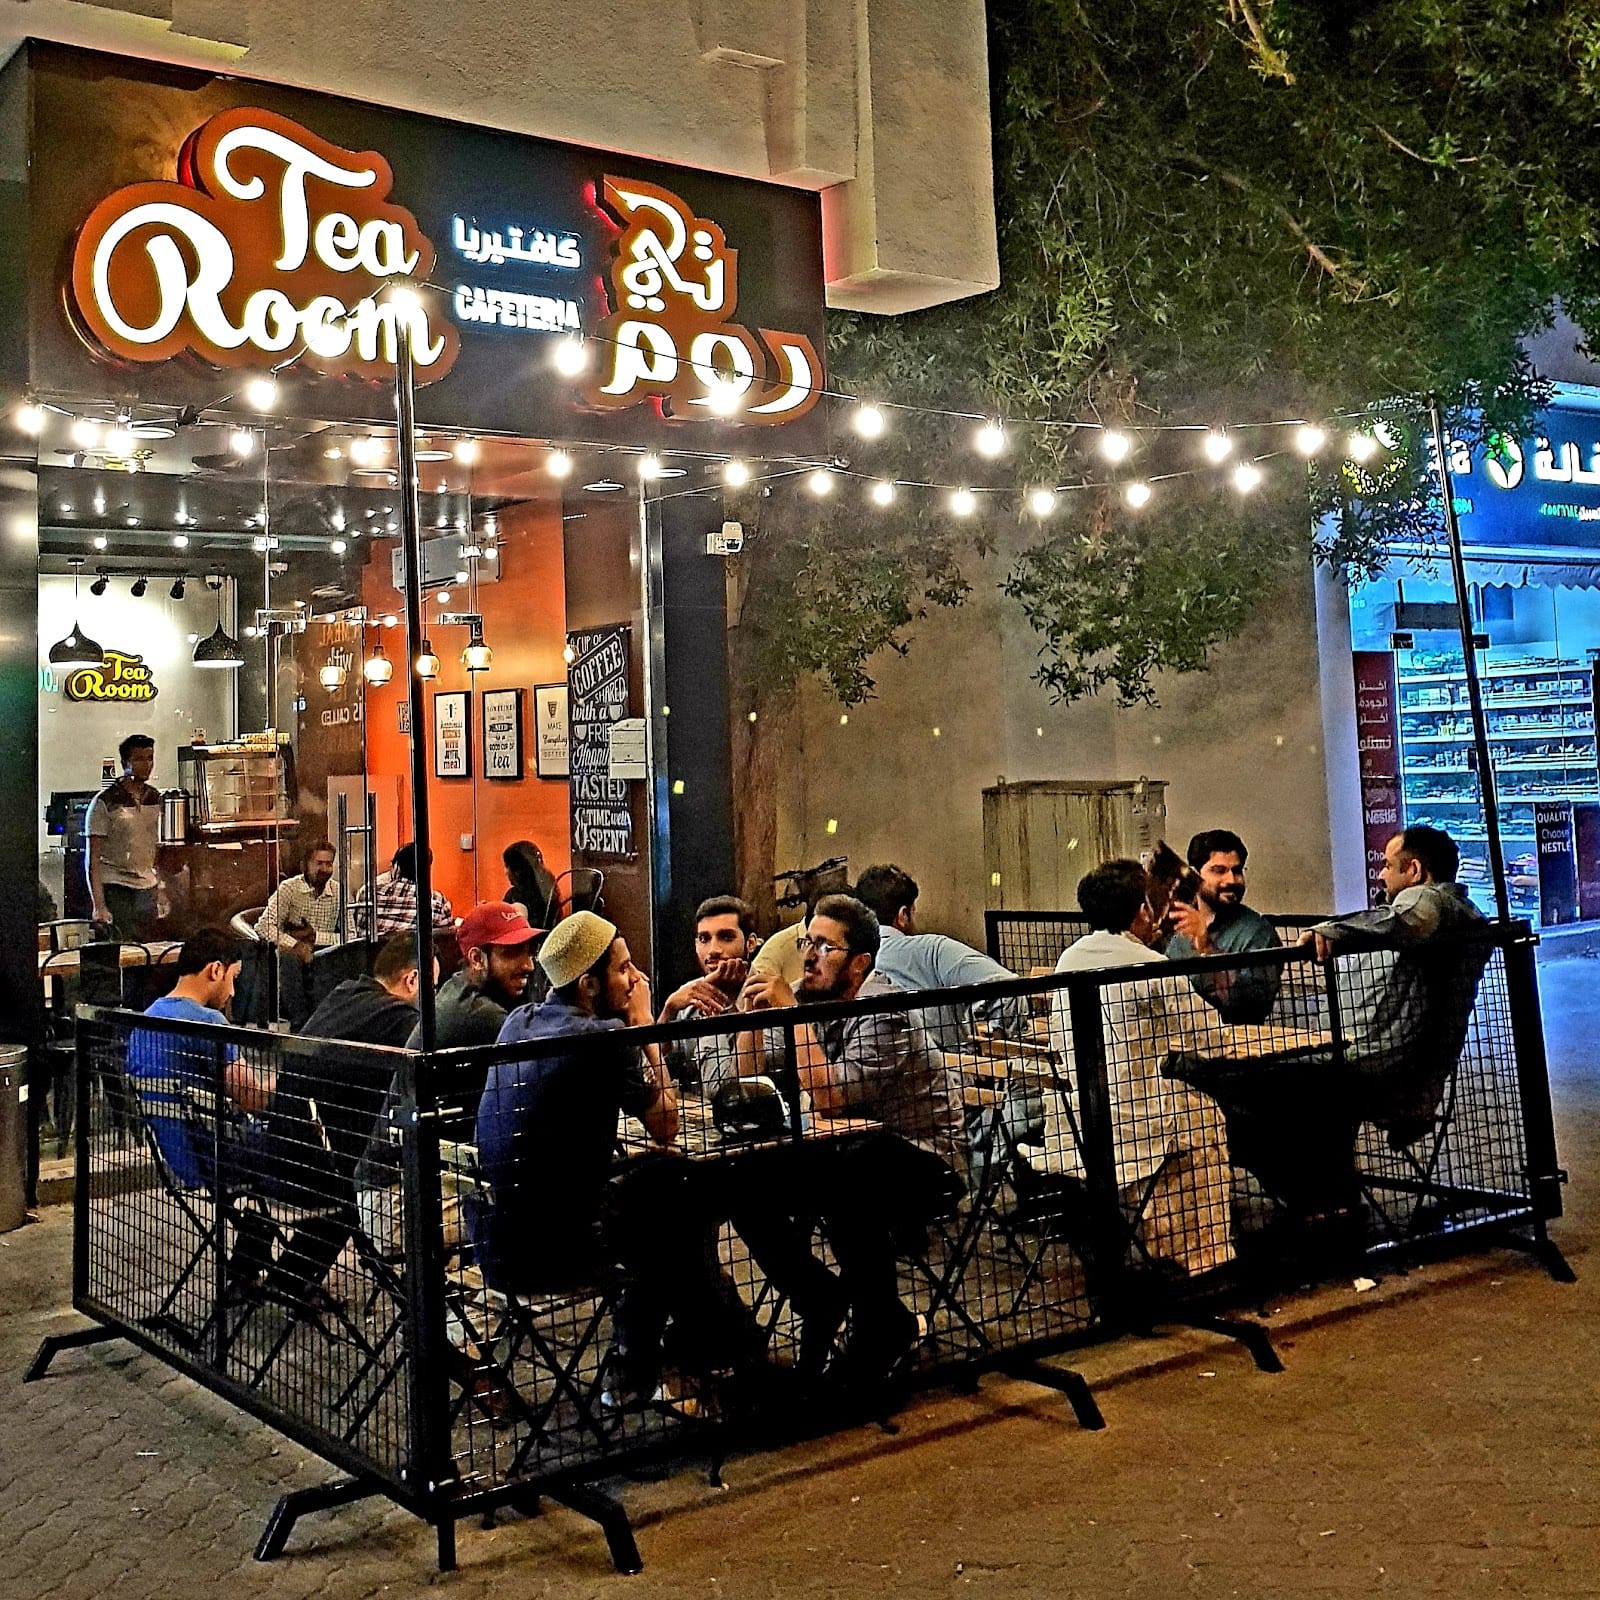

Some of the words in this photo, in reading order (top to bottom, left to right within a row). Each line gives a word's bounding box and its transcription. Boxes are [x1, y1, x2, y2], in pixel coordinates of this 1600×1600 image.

[214, 126, 419, 277] Tea
[454, 216, 581, 268] كافتيريا
[93, 202, 445, 367] Room
[456, 284, 581, 333] CAFETERIA
[600, 320, 812, 414] روم
[577, 635, 591, 656] CUP
[593, 633, 603, 646] OF
[102, 652, 149, 681] Tea
[574, 640, 621, 695] COFFEE
[72, 669, 154, 698] Room
[595, 677, 626, 704] SHARED
[572, 700, 597, 721] with
[599, 706, 608, 721] a
[588, 722, 614, 742] FRIE
[493, 752, 510, 768] tea
[573, 774, 626, 801] TASTED
[586, 809, 611, 826] TIME
[1537, 811, 1570, 823] QUALITY
[589, 829, 628, 853] SPENT
